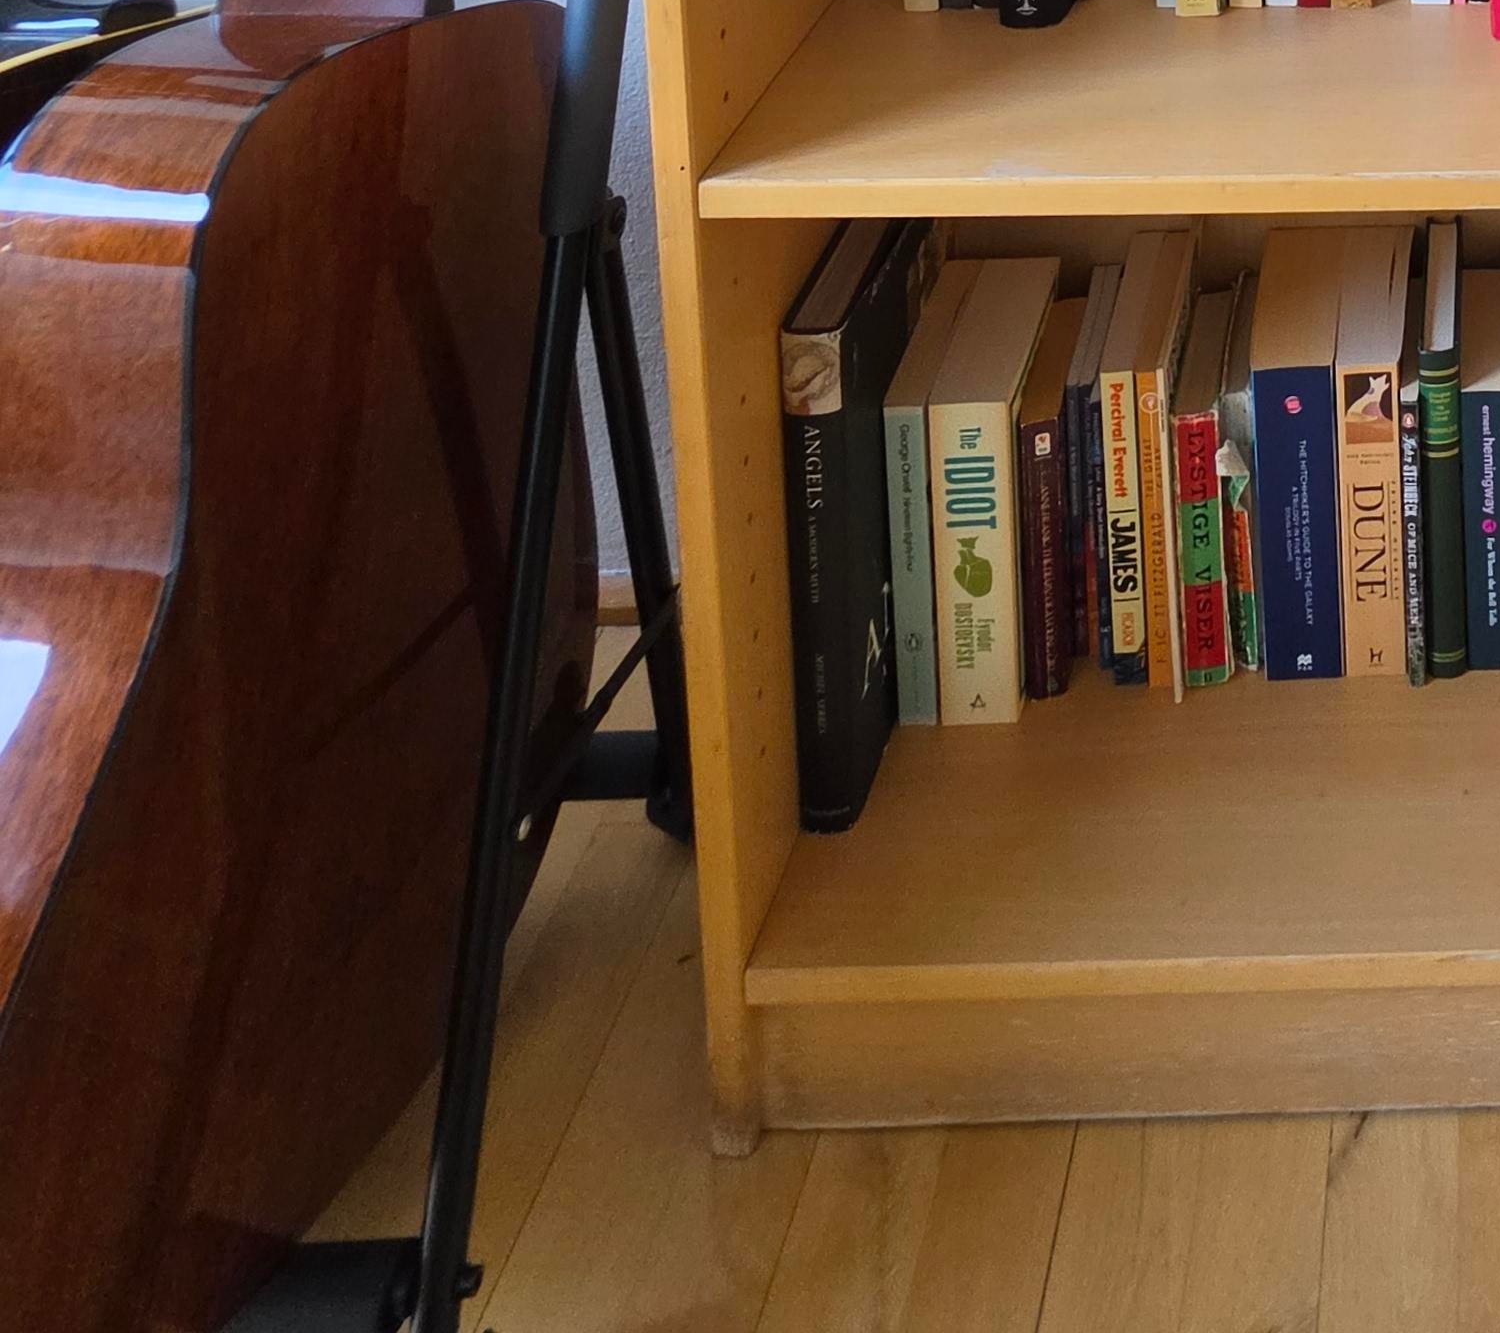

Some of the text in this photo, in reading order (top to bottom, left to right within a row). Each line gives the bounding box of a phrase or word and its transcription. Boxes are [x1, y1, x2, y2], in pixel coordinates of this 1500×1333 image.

[943, 427, 997, 529] The IDIOT
[1109, 383, 1128, 499] Percival Everett
[1481, 437, 1496, 515] hemingway
[1111, 517, 1139, 593] JAMES
[1187, 430, 1213, 653] LYSTIGE VISER
[1353, 483, 1387, 603] DUNE
